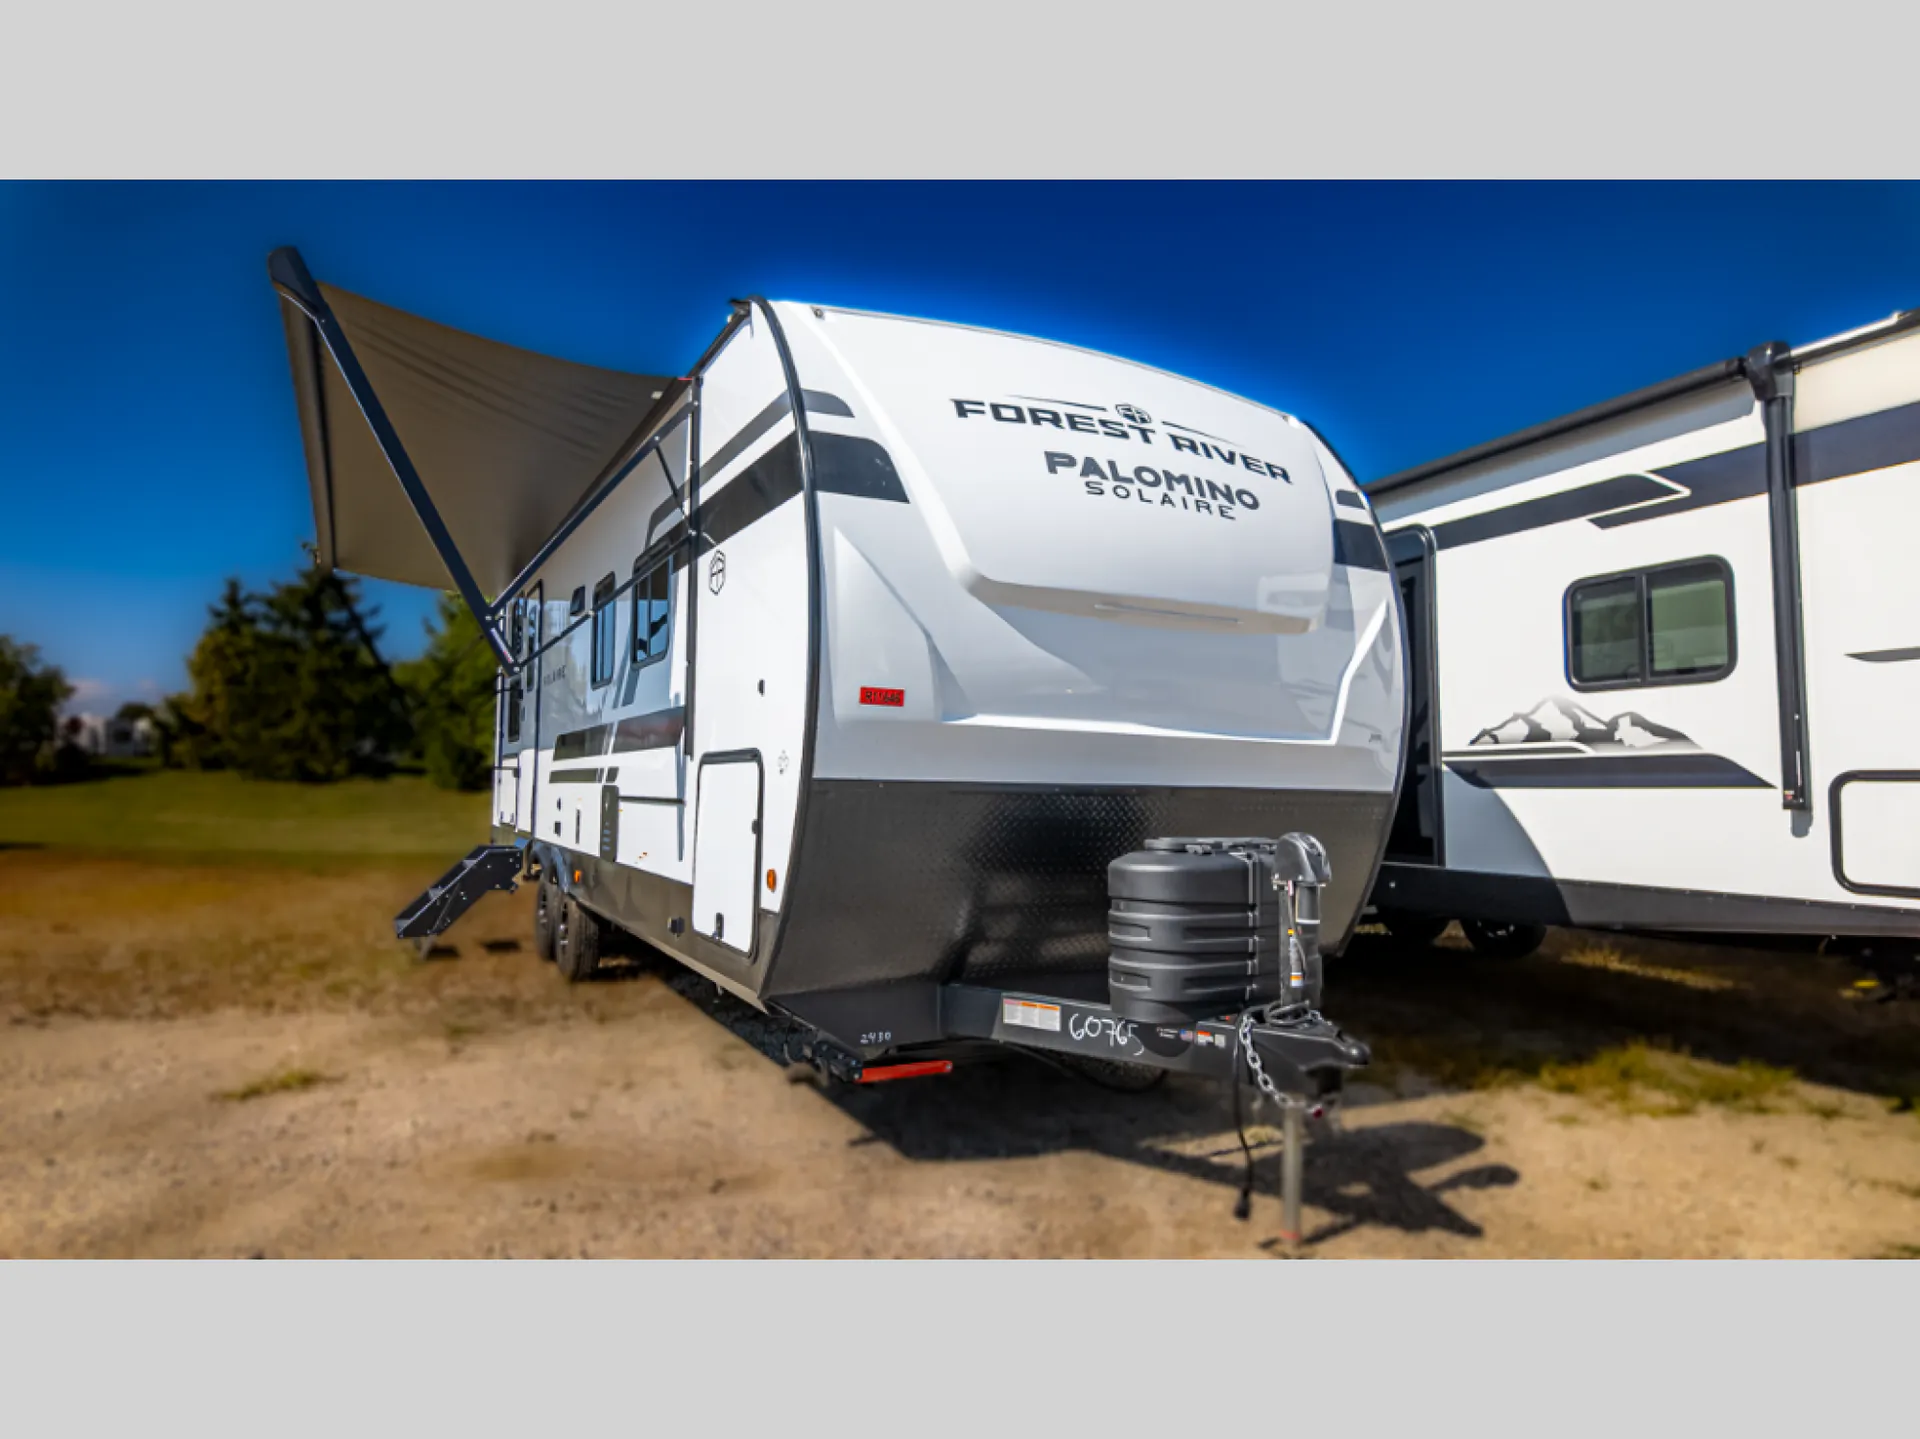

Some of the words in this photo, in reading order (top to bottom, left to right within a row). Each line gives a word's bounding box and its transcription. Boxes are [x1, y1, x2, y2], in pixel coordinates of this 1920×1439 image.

[949, 398, 1156, 444] FOREST
[1167, 432, 1294, 485] RIVER
[1044, 450, 1260, 510] PALOMINO
[1085, 480, 1236, 520] SOLAIRE
[1069, 1013, 1145, 1057] 60765
